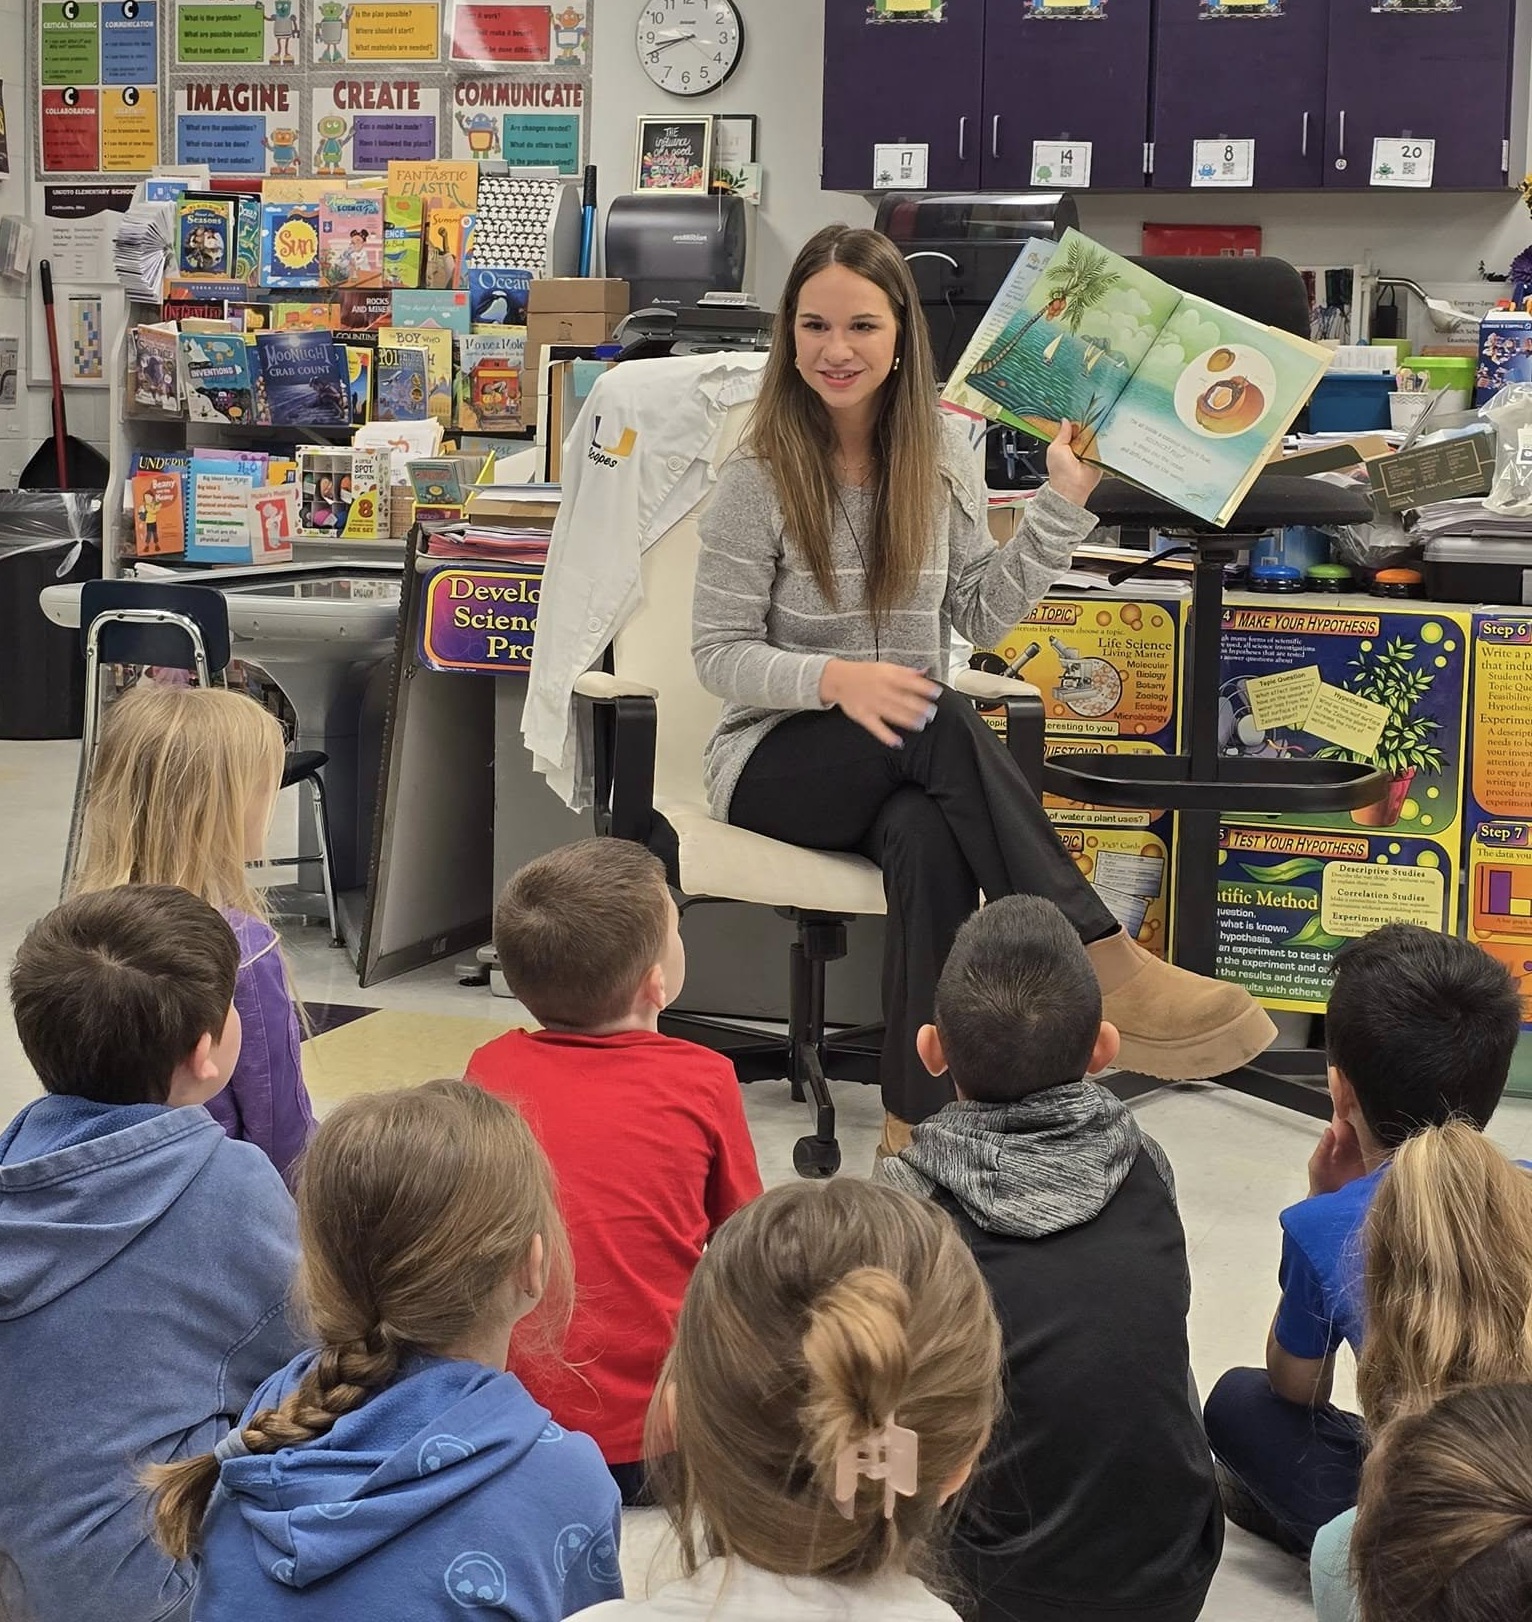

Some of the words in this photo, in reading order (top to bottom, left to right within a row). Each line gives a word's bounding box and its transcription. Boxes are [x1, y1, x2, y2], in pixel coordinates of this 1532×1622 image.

[216, 14, 242, 22] problem?
[386, 10, 412, 18] possible?
[650, 12, 664, 24] 10
[715, 12, 724, 24] 2
[234, 30, 262, 38] solutions?
[646, 32, 655, 44] 9
[719, 32, 728, 44] 3
[184, 46, 198, 54] What
[200, 46, 212, 54] have
[214, 46, 230, 54] others
[232, 46, 248, 54] done?
[650, 51, 660, 63] 8
[713, 52, 722, 64] 4
[663, 66, 673, 78] 7
[681, 71, 690, 84] 6
[700, 66, 708, 78] 5
[186, 83, 290, 112] IMAGINE
[333, 80, 420, 110] CREATE
[454, 82, 583, 107] COMMUNICATE
[522, 124, 545, 133] changes
[664, 127, 680, 137] THE
[655, 138, 691, 147] influence
[671, 146, 694, 156] good
[1060, 149, 1073, 165] 14
[1224, 145, 1234, 162] 8
[1401, 146, 1422, 159] 20
[901, 152, 913, 166] 17
[396, 170, 468, 180] FANTASTIC
[401, 182, 466, 208] ELASTIC
[187, 214, 222, 224] Seasons
[279, 230, 315, 258] Sun
[479, 270, 530, 290] Ocean
[352, 305, 367, 313] AND
[396, 332, 421, 343] BOY
[264, 343, 334, 370] MOONLIGHT
[190, 366, 234, 378] INVENTIONS
[269, 366, 295, 377] CRAB
[297, 366, 330, 375] COUNT
[354, 465, 372, 473] SPOT
[358, 499, 374, 518] 8
[448, 577, 541, 604] Develo
[1041, 606, 1072, 620] TOPIC
[1223, 611, 1230, 622] 4
[1239, 613, 1271, 628] MAKE
[1274, 614, 1304, 630] YOUR
[1307, 616, 1376, 634] HYPOTHESIS
[1483, 622, 1514, 638] Step
[1518, 624, 1526, 635] 6
[486, 636, 534, 660] Pro
[1098, 637, 1121, 648] Life
[1126, 639, 1172, 650] Science
[1274, 644, 1315, 652] investigations
[1103, 650, 1130, 658] Living
[1134, 650, 1166, 659] Matter
[1228, 648, 1261, 656] hypotheses
[1482, 647, 1511, 658] Write
[1126, 661, 1169, 669] Molecular
[1482, 660, 1501, 670] that
[1506, 661, 1532, 670] inclu
[1136, 671, 1166, 680] Biology
[1260, 679, 1276, 687] Topic
[1278, 672, 1306, 683] Question
[1488, 671, 1522, 680] Student
[1136, 682, 1166, 690] Botany
[1488, 682, 1513, 691] Topic
[1135, 692, 1168, 700] Zoology
[1334, 692, 1368, 710] Hypothesis
[1488, 692, 1530, 702] Feasibility
[1134, 702, 1167, 712] Ecology
[1114, 712, 1168, 723] Microbiology
[1086, 721, 1095, 730] to
[1097, 724, 1116, 733] you.
[1488, 727, 1494, 735] A
[1488, 738, 1511, 746] needs
[1485, 778, 1516, 787] writing
[1060, 814, 1084, 822] water
[1094, 814, 1116, 824] plant
[1118, 815, 1143, 824] uses?
[1481, 825, 1511, 841] Step
[1515, 827, 1522, 839] 7
[1220, 829, 1225, 840] 5
[1232, 832, 1261, 848] TEST
[1263, 834, 1293, 850] YOUR
[1294, 837, 1365, 856] HYPOTHESIS
[1477, 848, 1494, 856] The
[1495, 850, 1514, 858] data
[1339, 864, 1389, 875] Descriptive
[1392, 869, 1426, 878] Studies
[1256, 890, 1318, 910] Method
[1337, 888, 1389, 899] Correlation
[1392, 892, 1425, 902] Studies
[1332, 912, 1392, 923] Experimental
[1395, 917, 1428, 926] Studies
[1220, 919, 1244, 930] what
[1246, 920, 1254, 930] is
[1256, 922, 1289, 934] known.
[1220, 931, 1273, 944] hypothesis.
[1219, 944, 1230, 952] an
[1232, 946, 1286, 957] experiment
[1287, 950, 1298, 958] to
[1300, 951, 1320, 960] test
[1224, 956, 1240, 965] the
[1242, 958, 1296, 970] experiment
[1298, 963, 1316, 972] and
[1220, 968, 1236, 976] the
[1238, 970, 1272, 981] results
[1274, 972, 1292, 982] and
[1294, 974, 1319, 984] draw
[1266, 984, 1286, 994] with
[1289, 986, 1323, 998] others.
